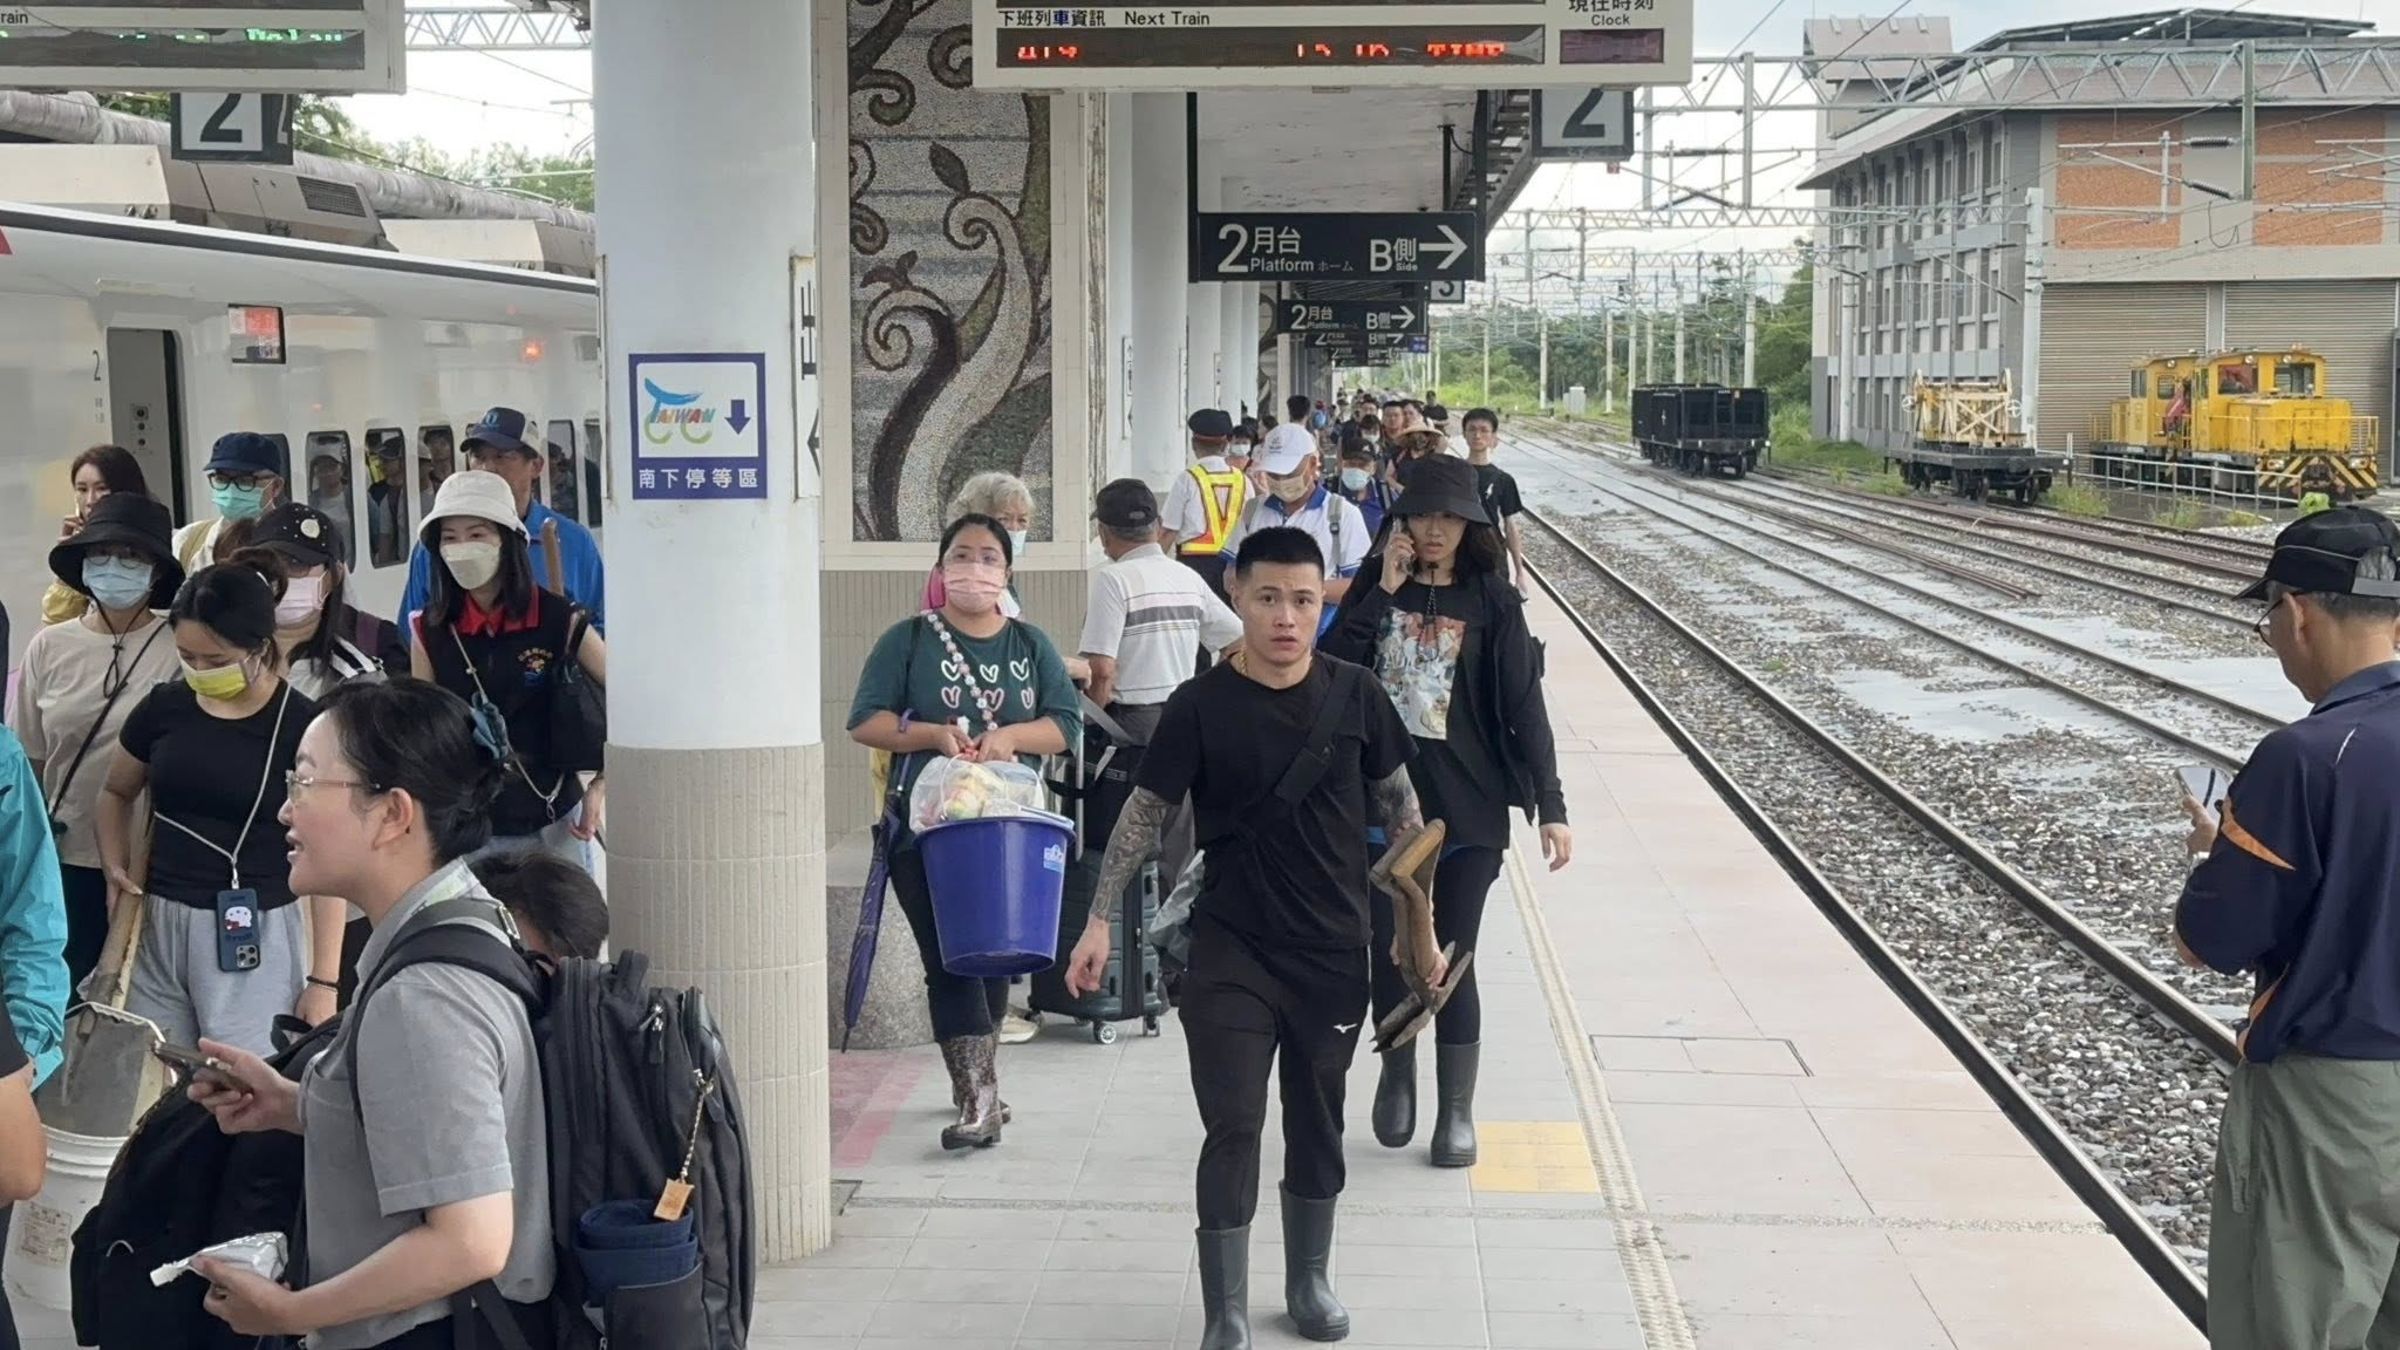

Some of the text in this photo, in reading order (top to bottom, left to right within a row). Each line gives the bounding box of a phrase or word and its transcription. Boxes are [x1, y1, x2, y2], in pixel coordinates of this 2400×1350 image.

[999, 9, 1106, 27] 下班列車資訊
[1125, 11, 1210, 26] Next Train
[1591, 14, 1630, 26] Clock
[200, 93, 242, 142] 2
[1562, 88, 1606, 138] 2
[1250, 257, 1353, 272] Platform ホーム
[1396, 262, 1418, 271] Side
[638, 467, 759, 490] 南下停等區
